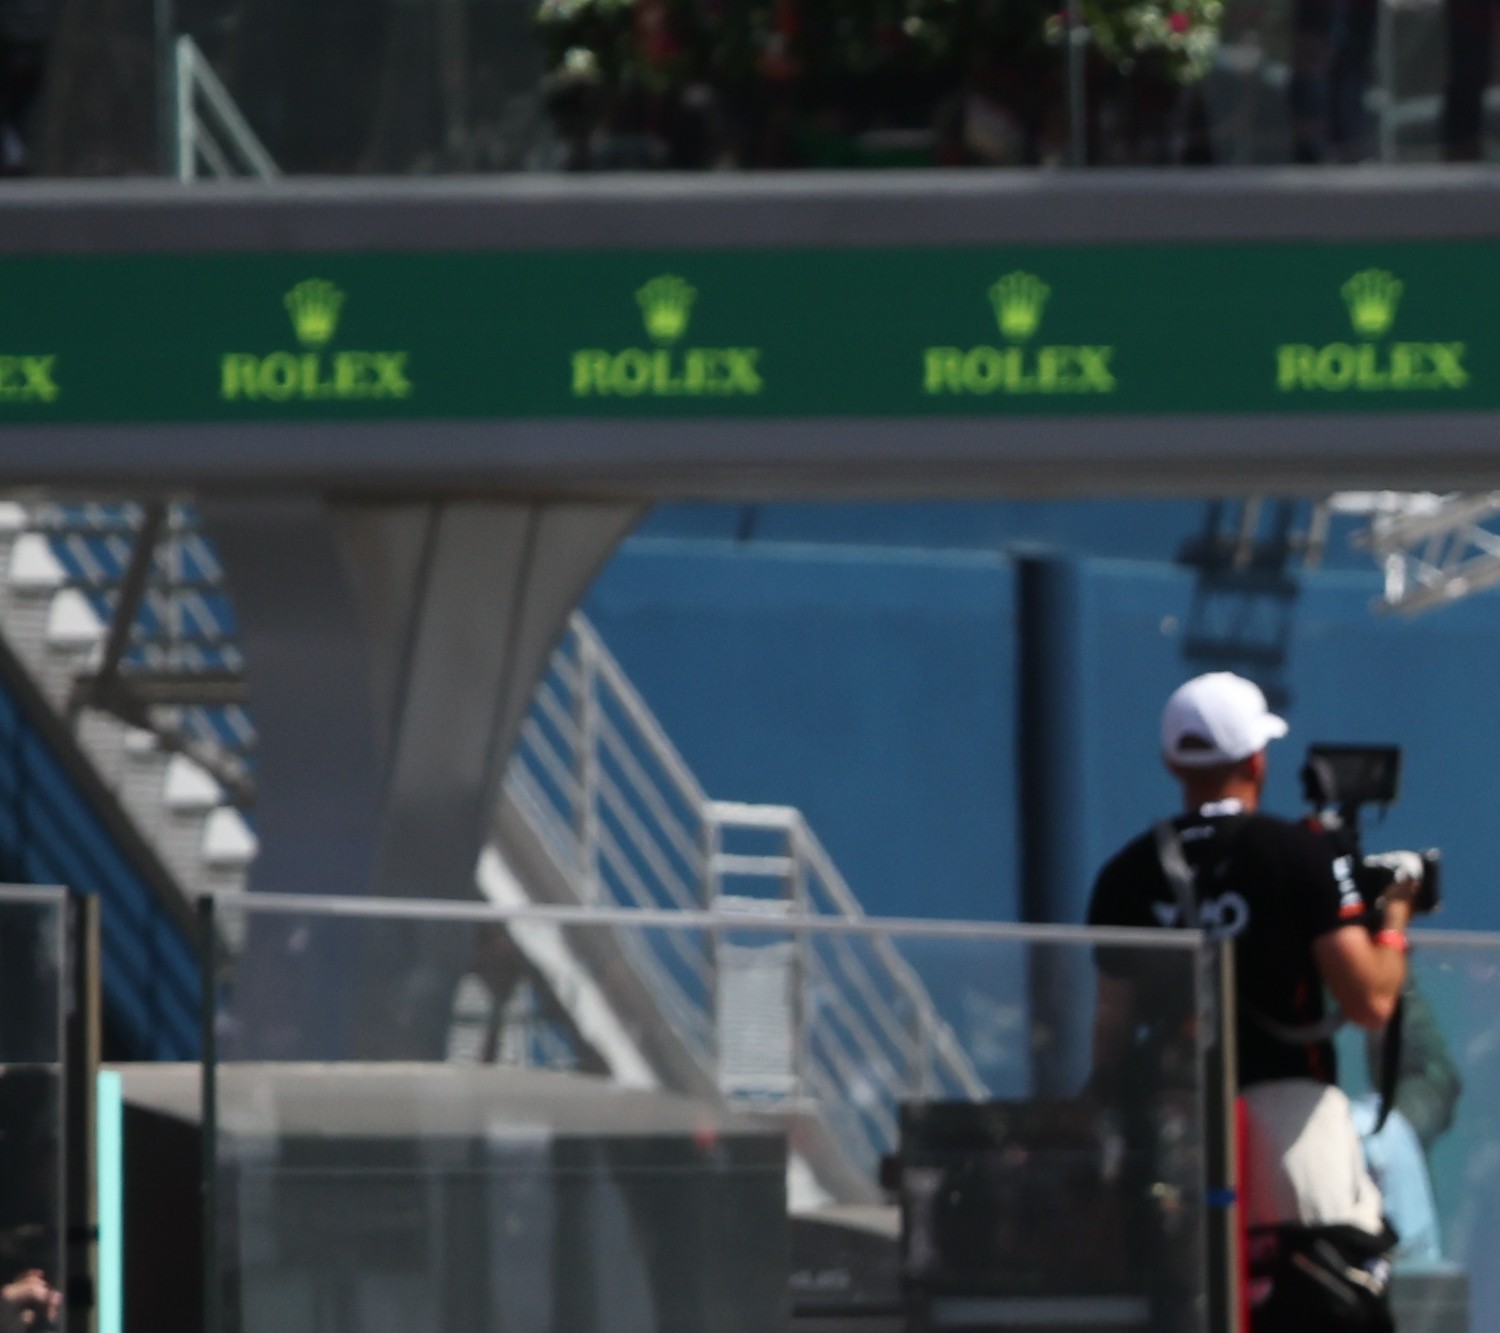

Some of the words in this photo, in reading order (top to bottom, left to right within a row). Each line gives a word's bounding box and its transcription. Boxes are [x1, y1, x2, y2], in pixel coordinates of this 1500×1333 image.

[222, 352, 409, 399] ROLEX
[572, 348, 761, 395] ROLEX
[924, 346, 1114, 392] ROLEX
[1278, 343, 1467, 389] ROLEX
